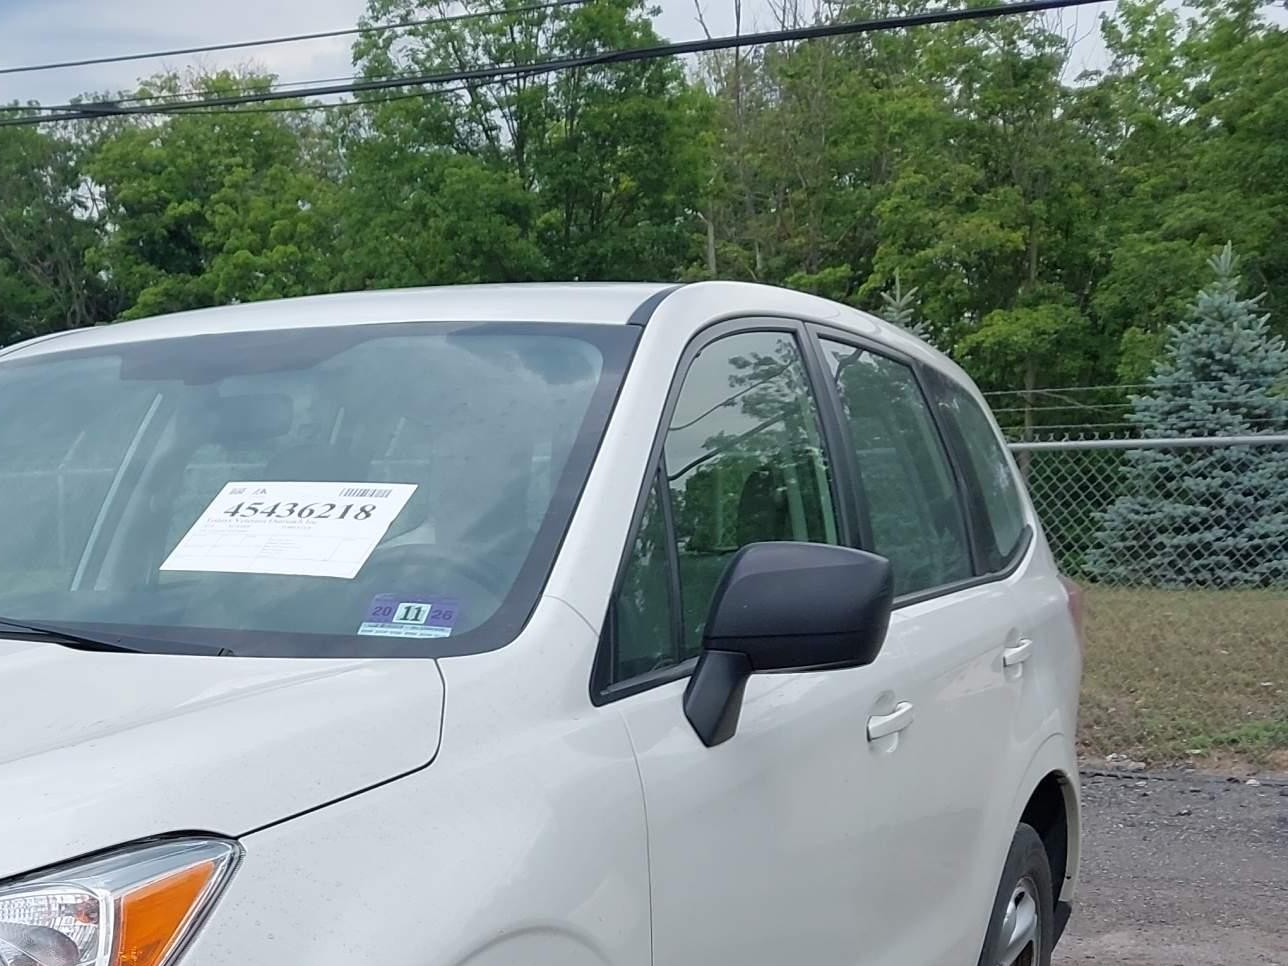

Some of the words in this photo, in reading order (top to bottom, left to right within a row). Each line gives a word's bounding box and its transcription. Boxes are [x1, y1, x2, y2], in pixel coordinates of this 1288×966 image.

[223, 501, 377, 521] 45436218
[372, 606, 393, 617] 20
[399, 605, 424, 622] 11
